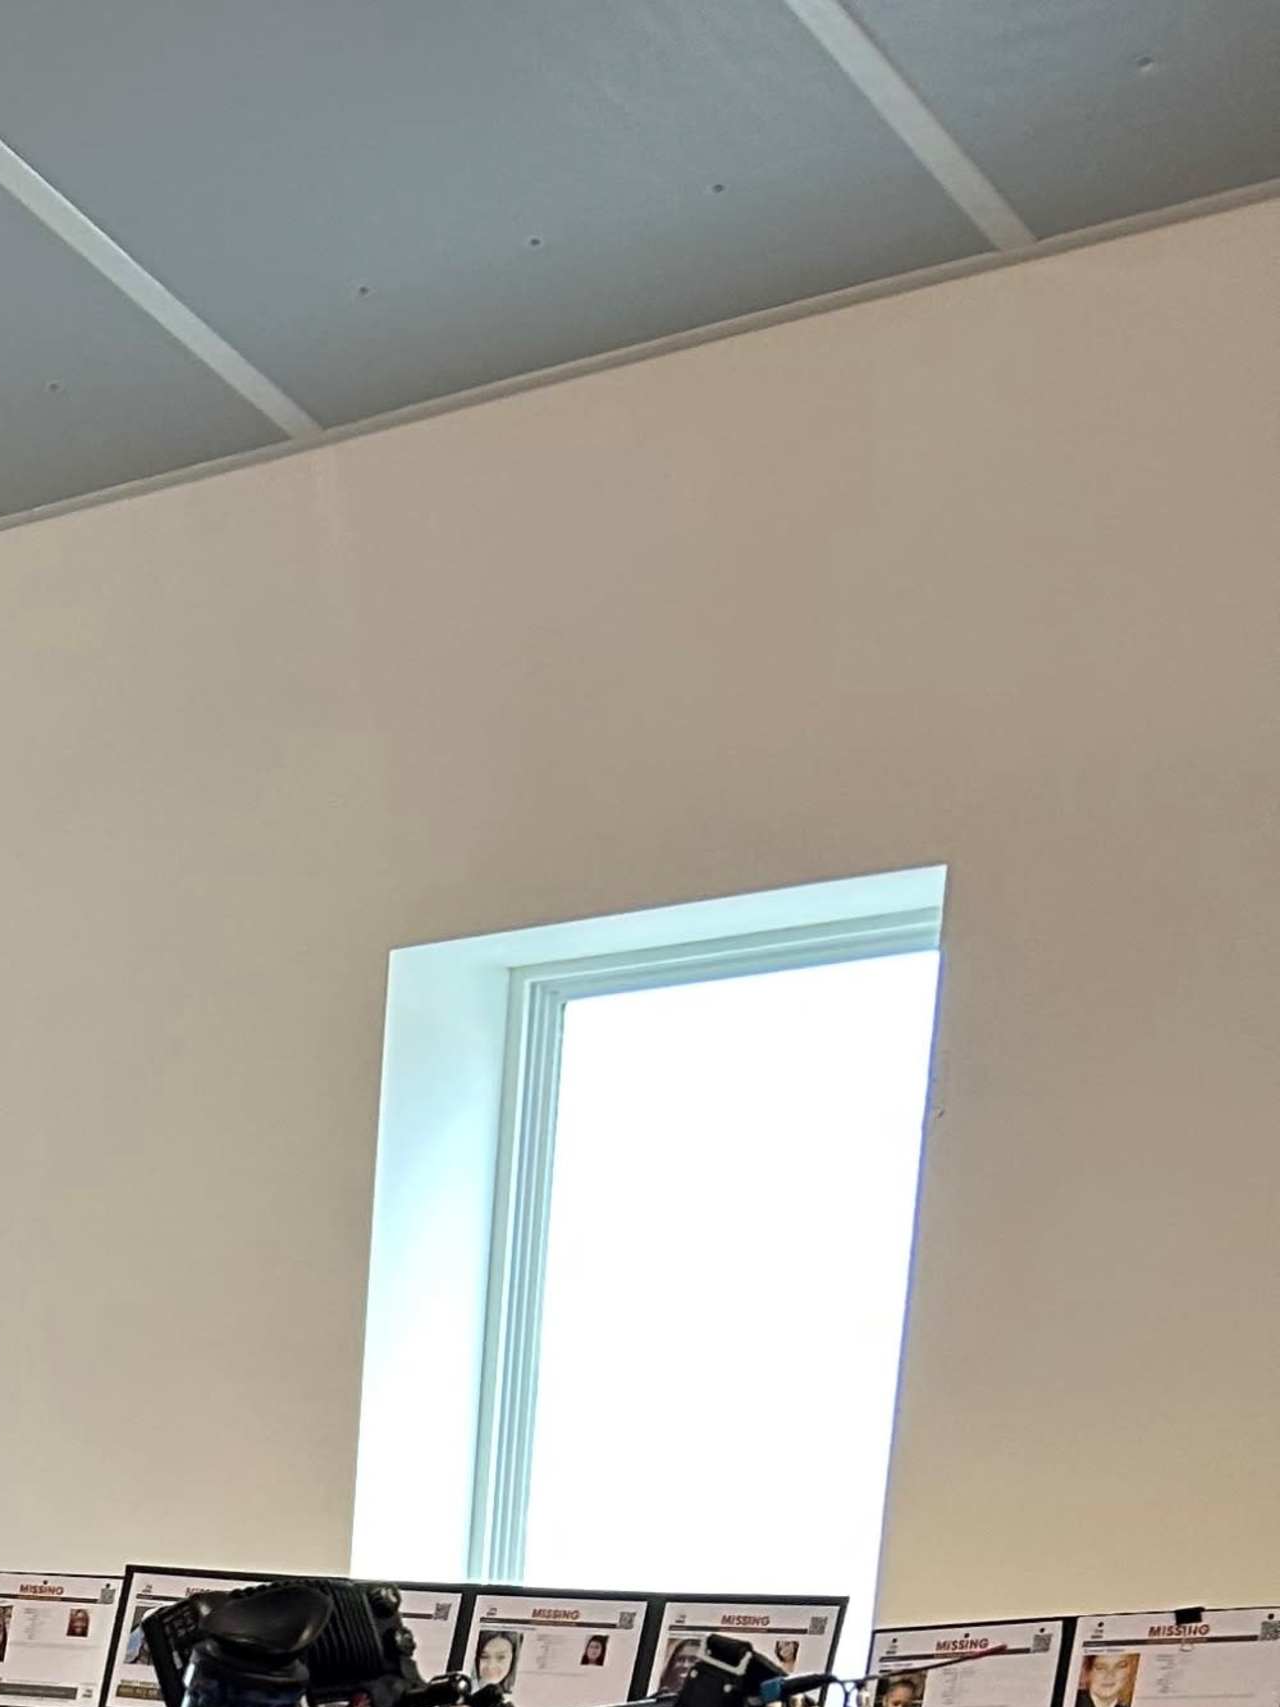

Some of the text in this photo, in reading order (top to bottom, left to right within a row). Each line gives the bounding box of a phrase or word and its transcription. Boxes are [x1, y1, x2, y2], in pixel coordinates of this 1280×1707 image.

[19, 1584, 64, 1595] MISSING
[532, 1608, 580, 1620] MISSING
[720, 1615, 770, 1626] MISSING
[1148, 1624, 1210, 1636] MISSING
[936, 1638, 989, 1650] MISSING
